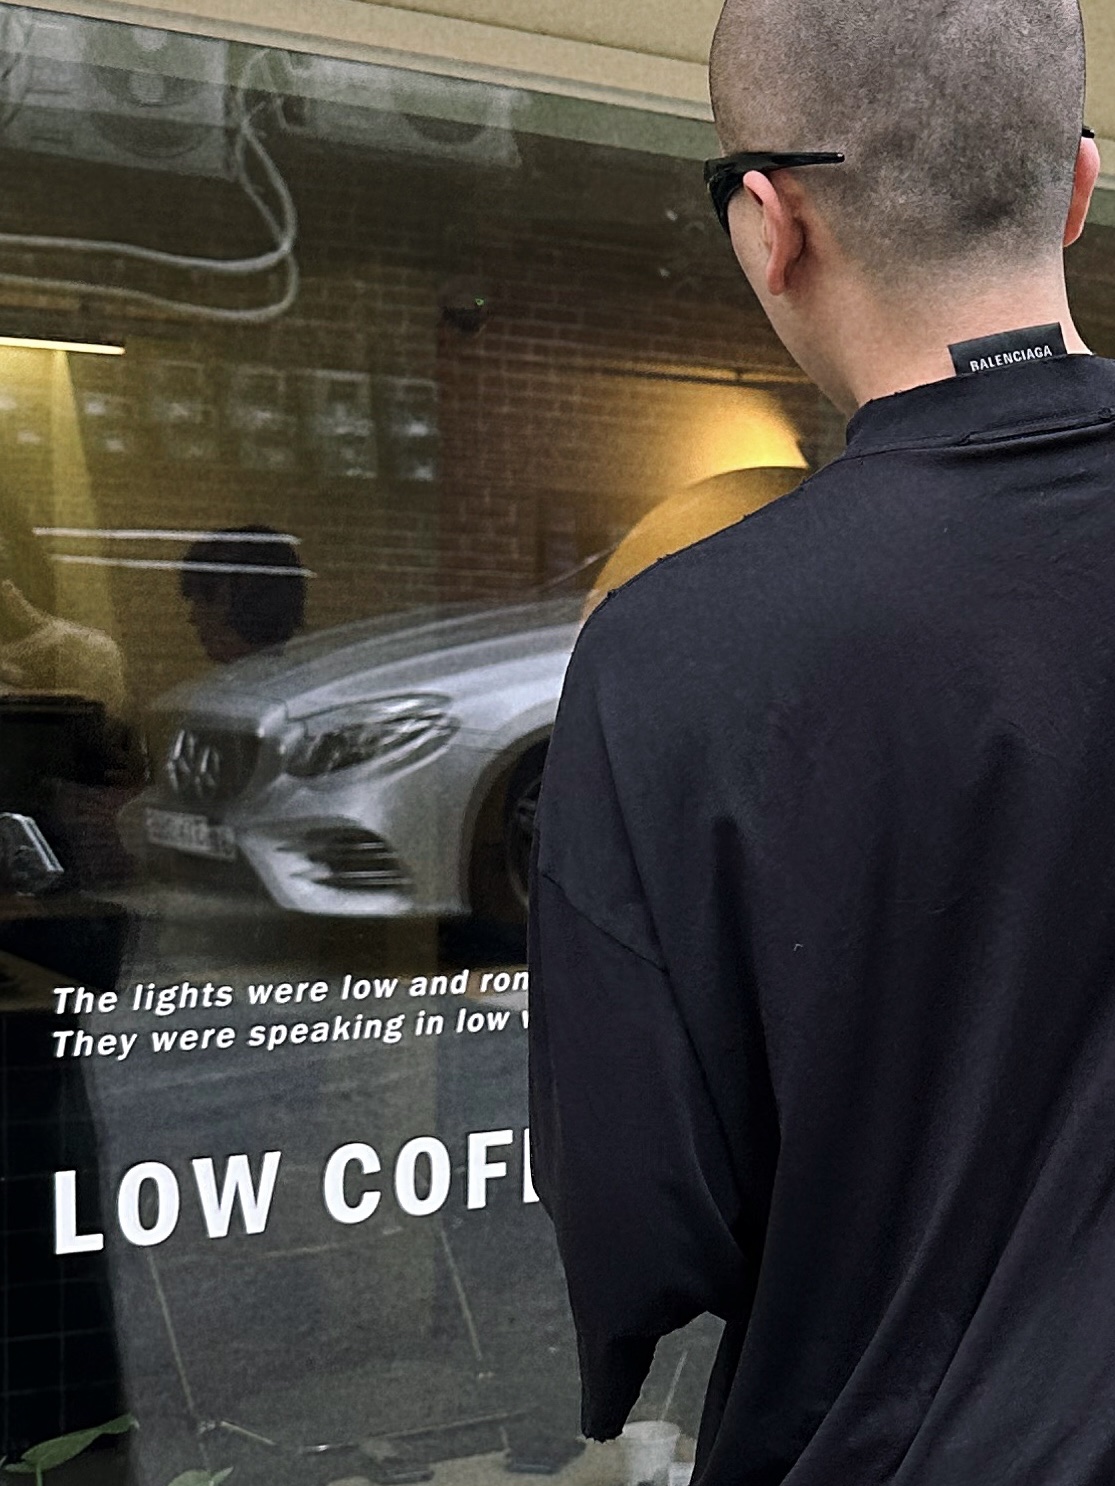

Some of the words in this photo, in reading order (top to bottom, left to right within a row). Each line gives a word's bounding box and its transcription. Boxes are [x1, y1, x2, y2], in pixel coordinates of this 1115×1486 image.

[969, 345, 1053, 372] BALENCIAGA
[53, 986, 118, 1014] The
[132, 981, 233, 1016] lights
[248, 980, 329, 1004] were
[341, 974, 399, 1000] low
[408, 968, 470, 997] and
[53, 1030, 138, 1061] They
[151, 1026, 236, 1053] were
[246, 1013, 406, 1051] speaking
[414, 1009, 445, 1036] in
[456, 1007, 511, 1034] low
[54, 1150, 282, 1255] LOW
[323, 1127, 541, 1224] COF
